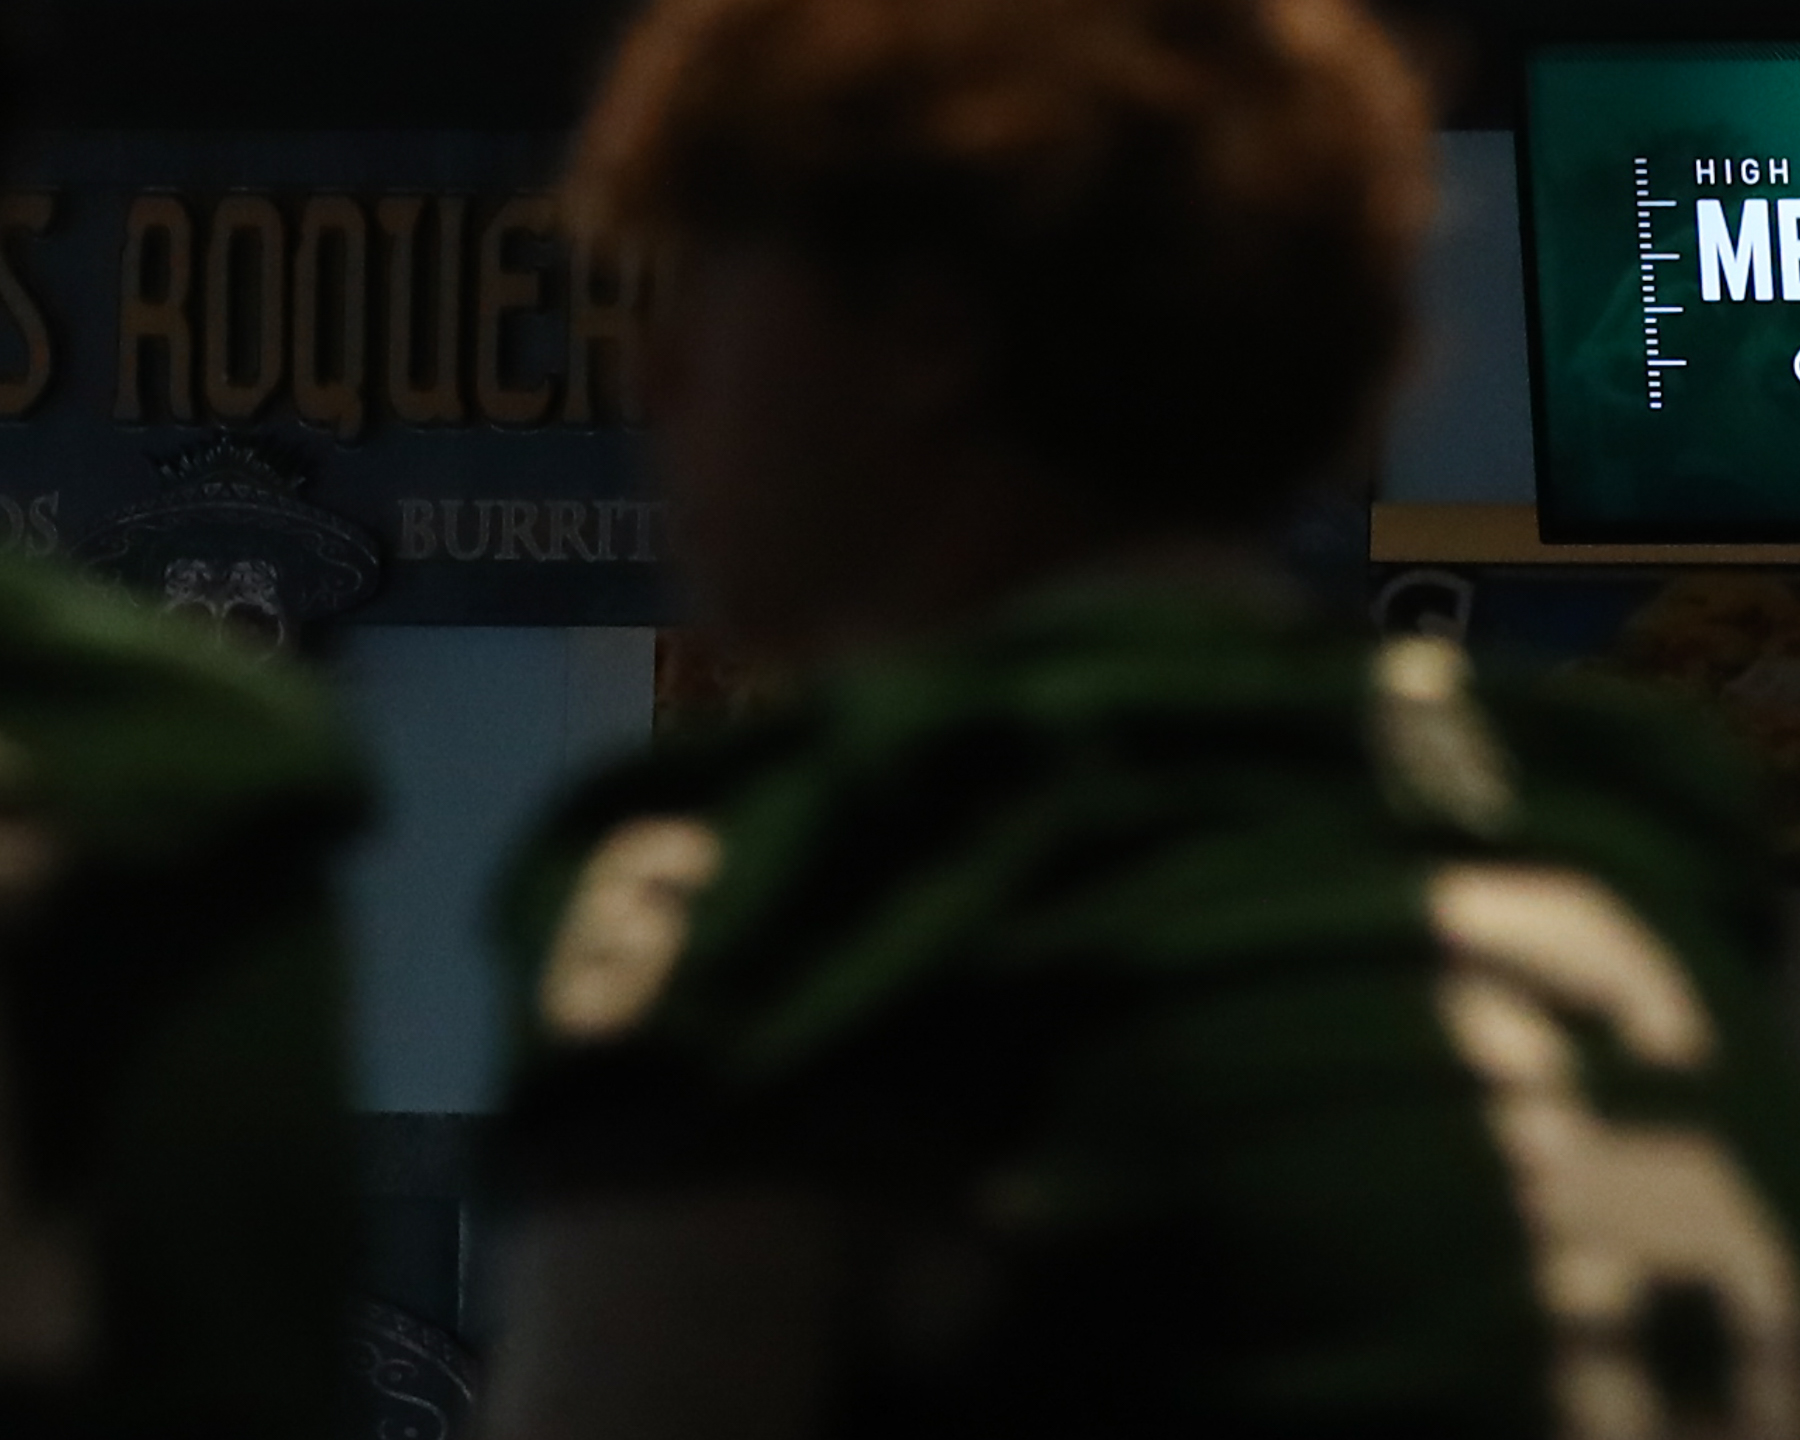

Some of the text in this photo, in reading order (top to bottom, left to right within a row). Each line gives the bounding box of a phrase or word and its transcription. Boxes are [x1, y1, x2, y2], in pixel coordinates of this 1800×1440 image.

[1695, 157, 1790, 186] HIGH
[112, 190, 665, 448] ROQUER
[396, 497, 668, 563] BURRIT
